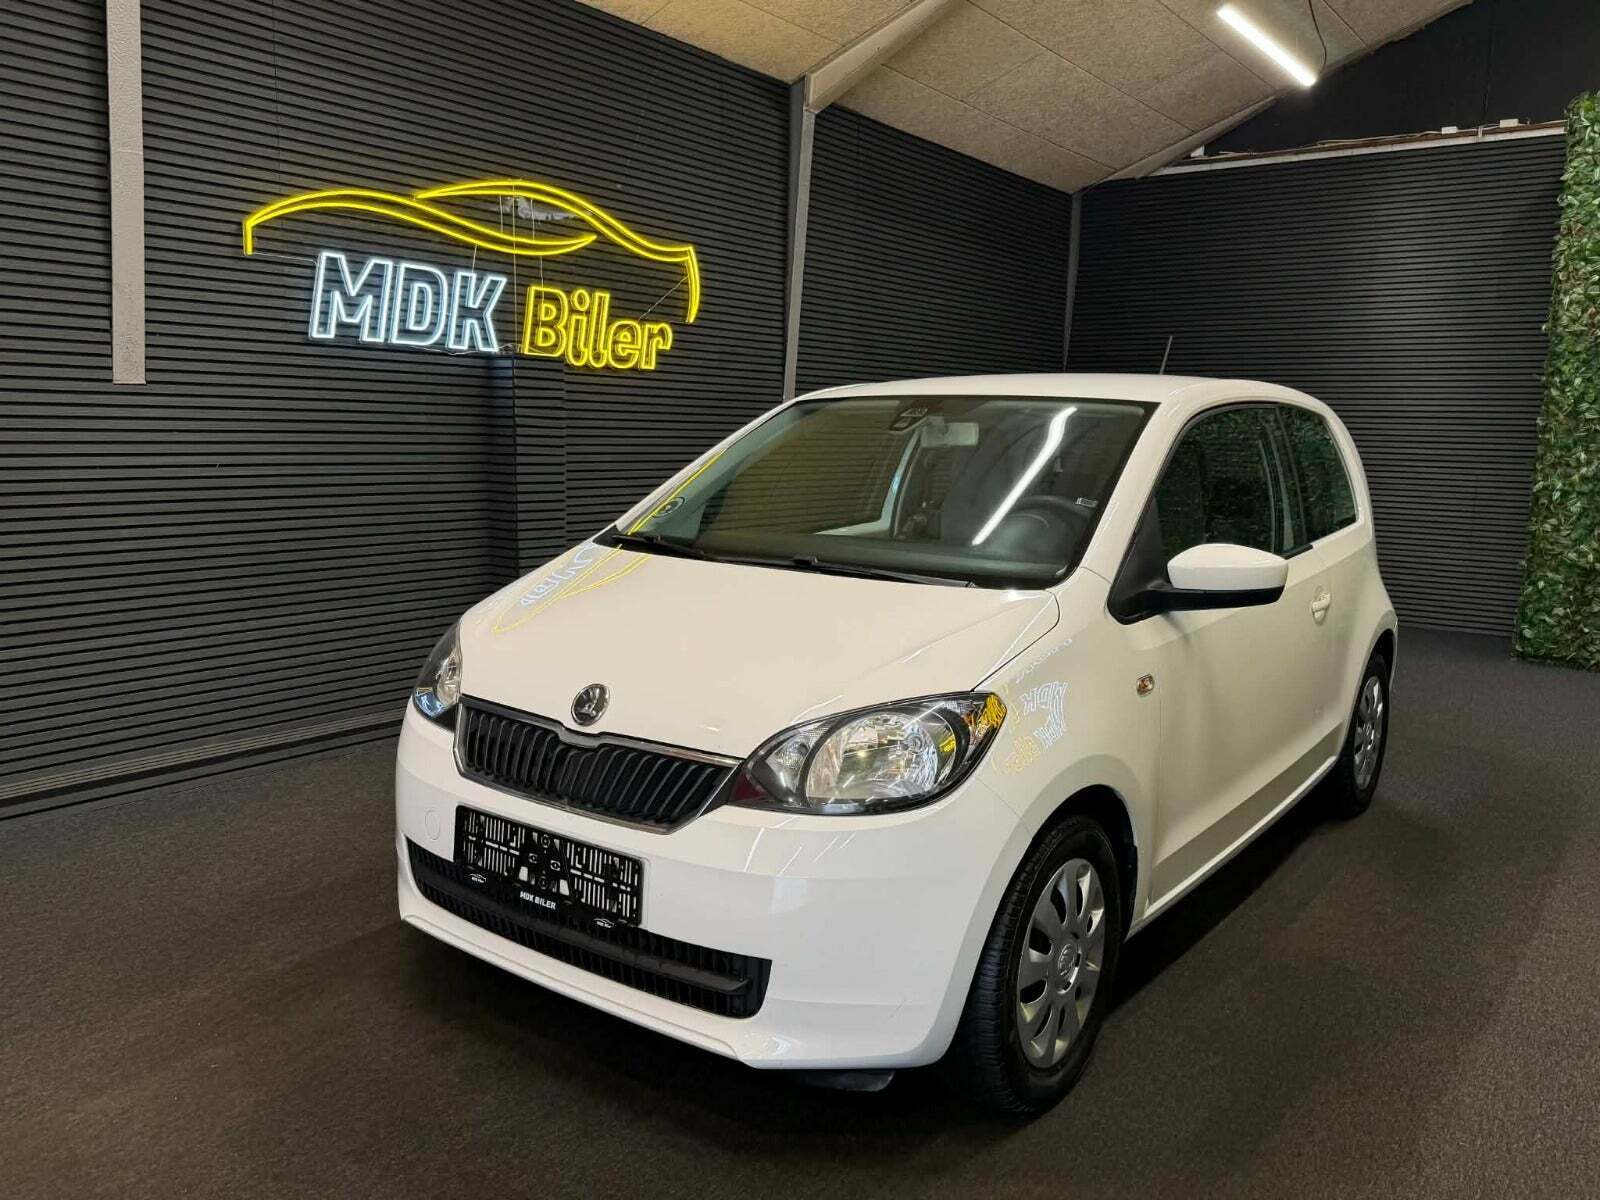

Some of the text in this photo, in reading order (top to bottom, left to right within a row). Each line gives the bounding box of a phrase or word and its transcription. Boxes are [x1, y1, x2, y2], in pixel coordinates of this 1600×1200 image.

[309, 252, 673, 370] MDK Biler
[534, 896, 557, 910] BILER
